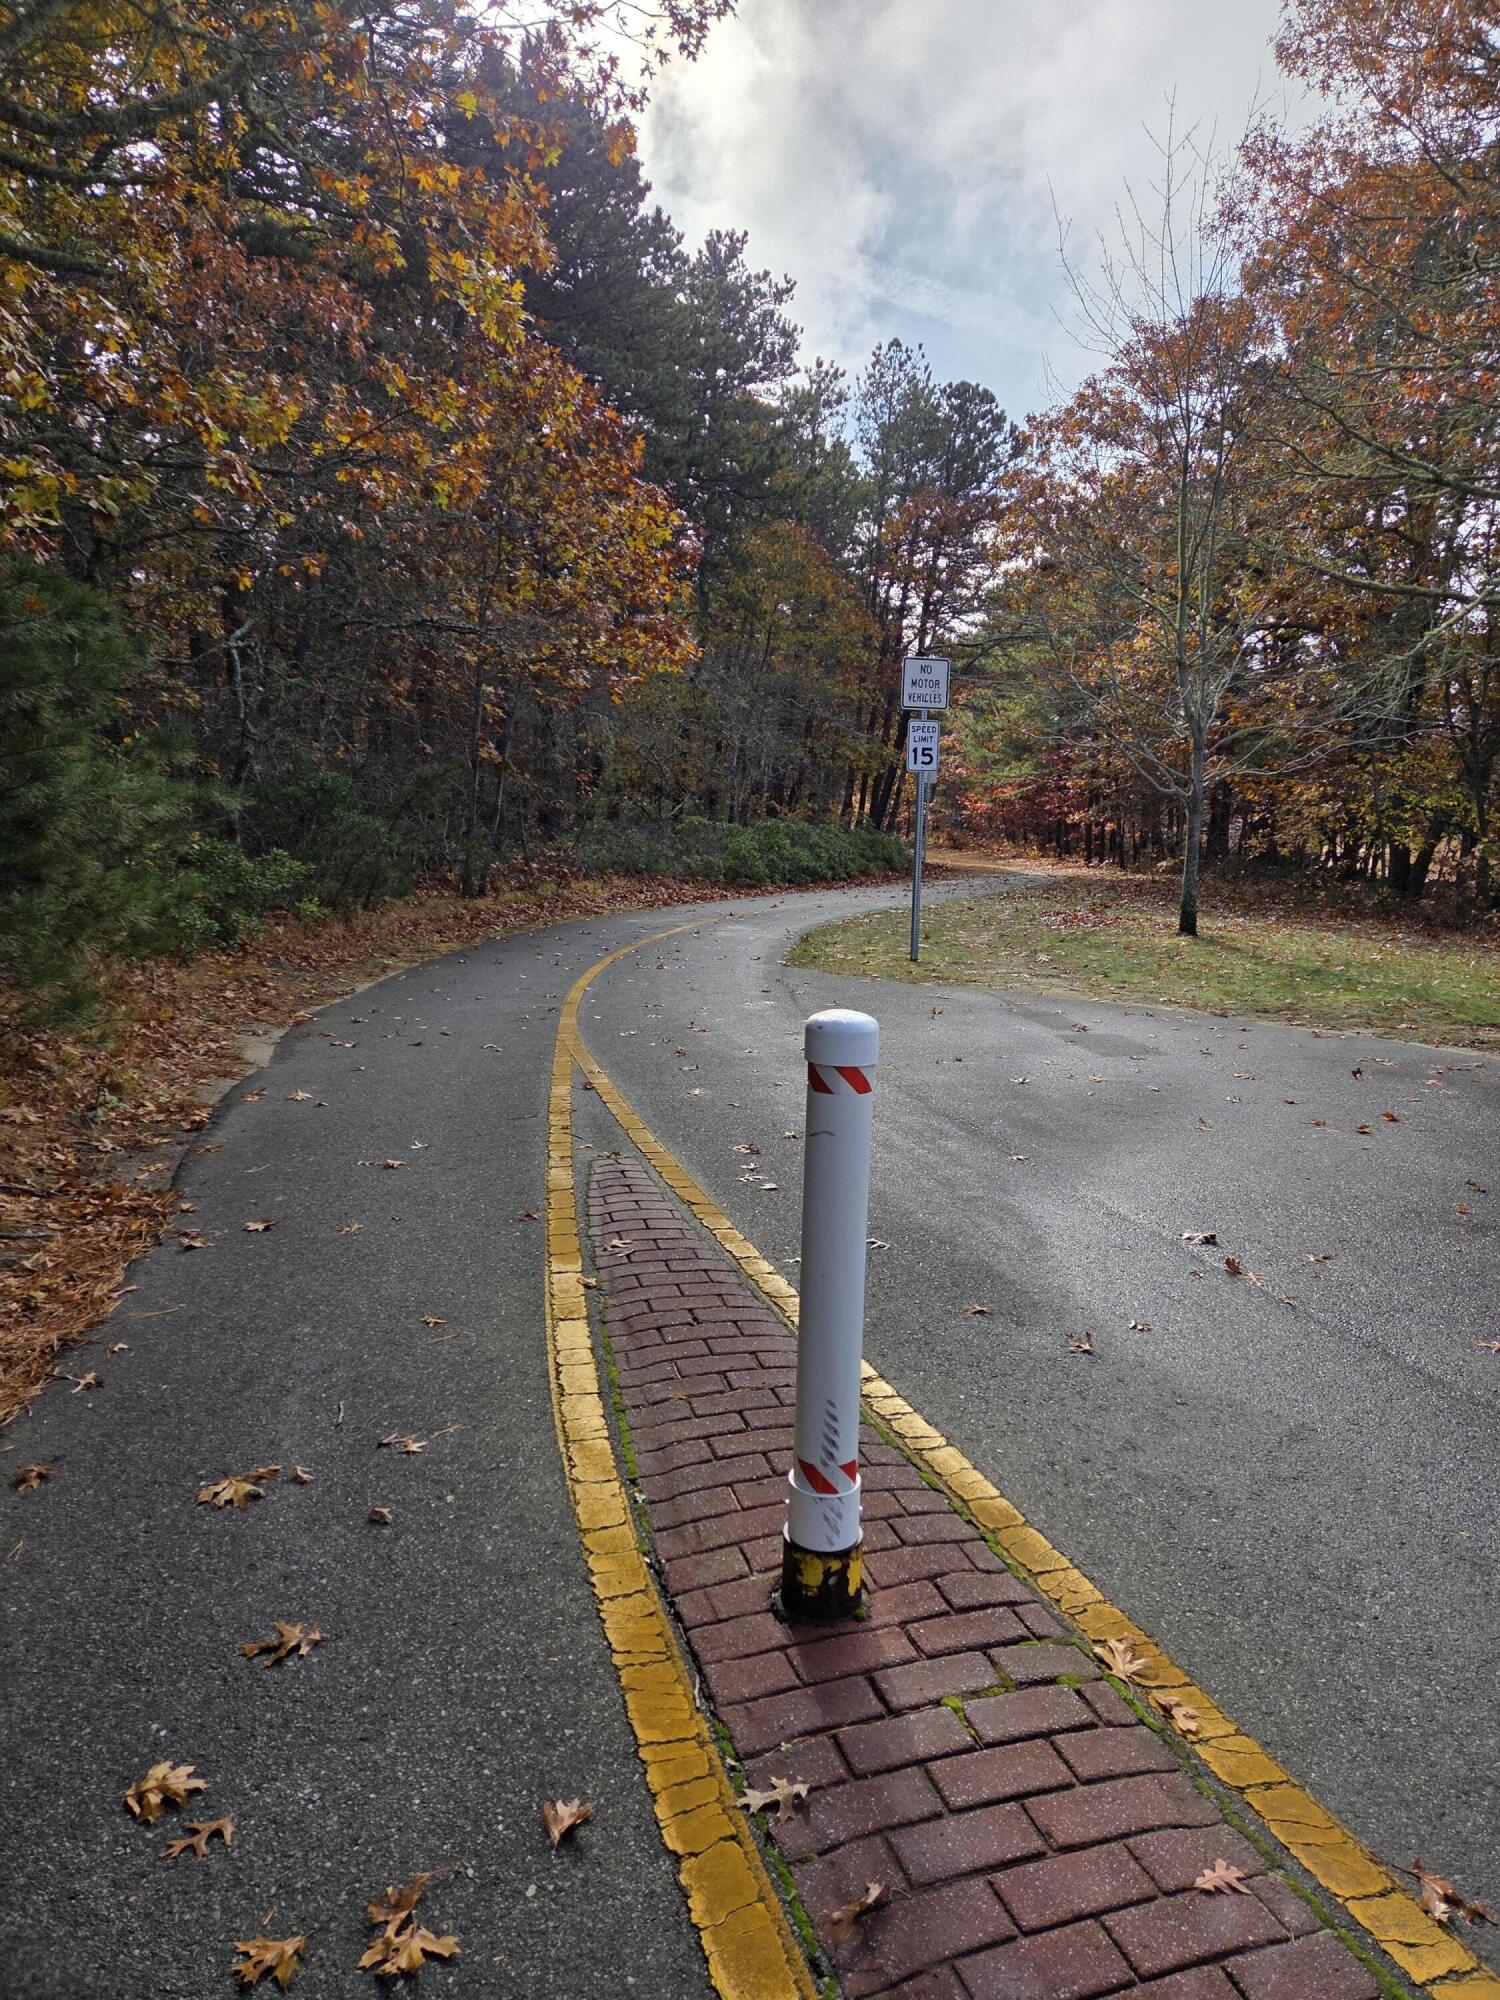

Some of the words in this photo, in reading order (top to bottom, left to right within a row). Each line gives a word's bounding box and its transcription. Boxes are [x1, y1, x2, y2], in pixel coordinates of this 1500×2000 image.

[920, 664, 932, 674] NO
[911, 678, 940, 689] MOTOR
[908, 692, 942, 704] VEHICLES
[911, 725, 937, 734] SPEED
[914, 735, 934, 744] LIMIT
[912, 747, 934, 766] 15
